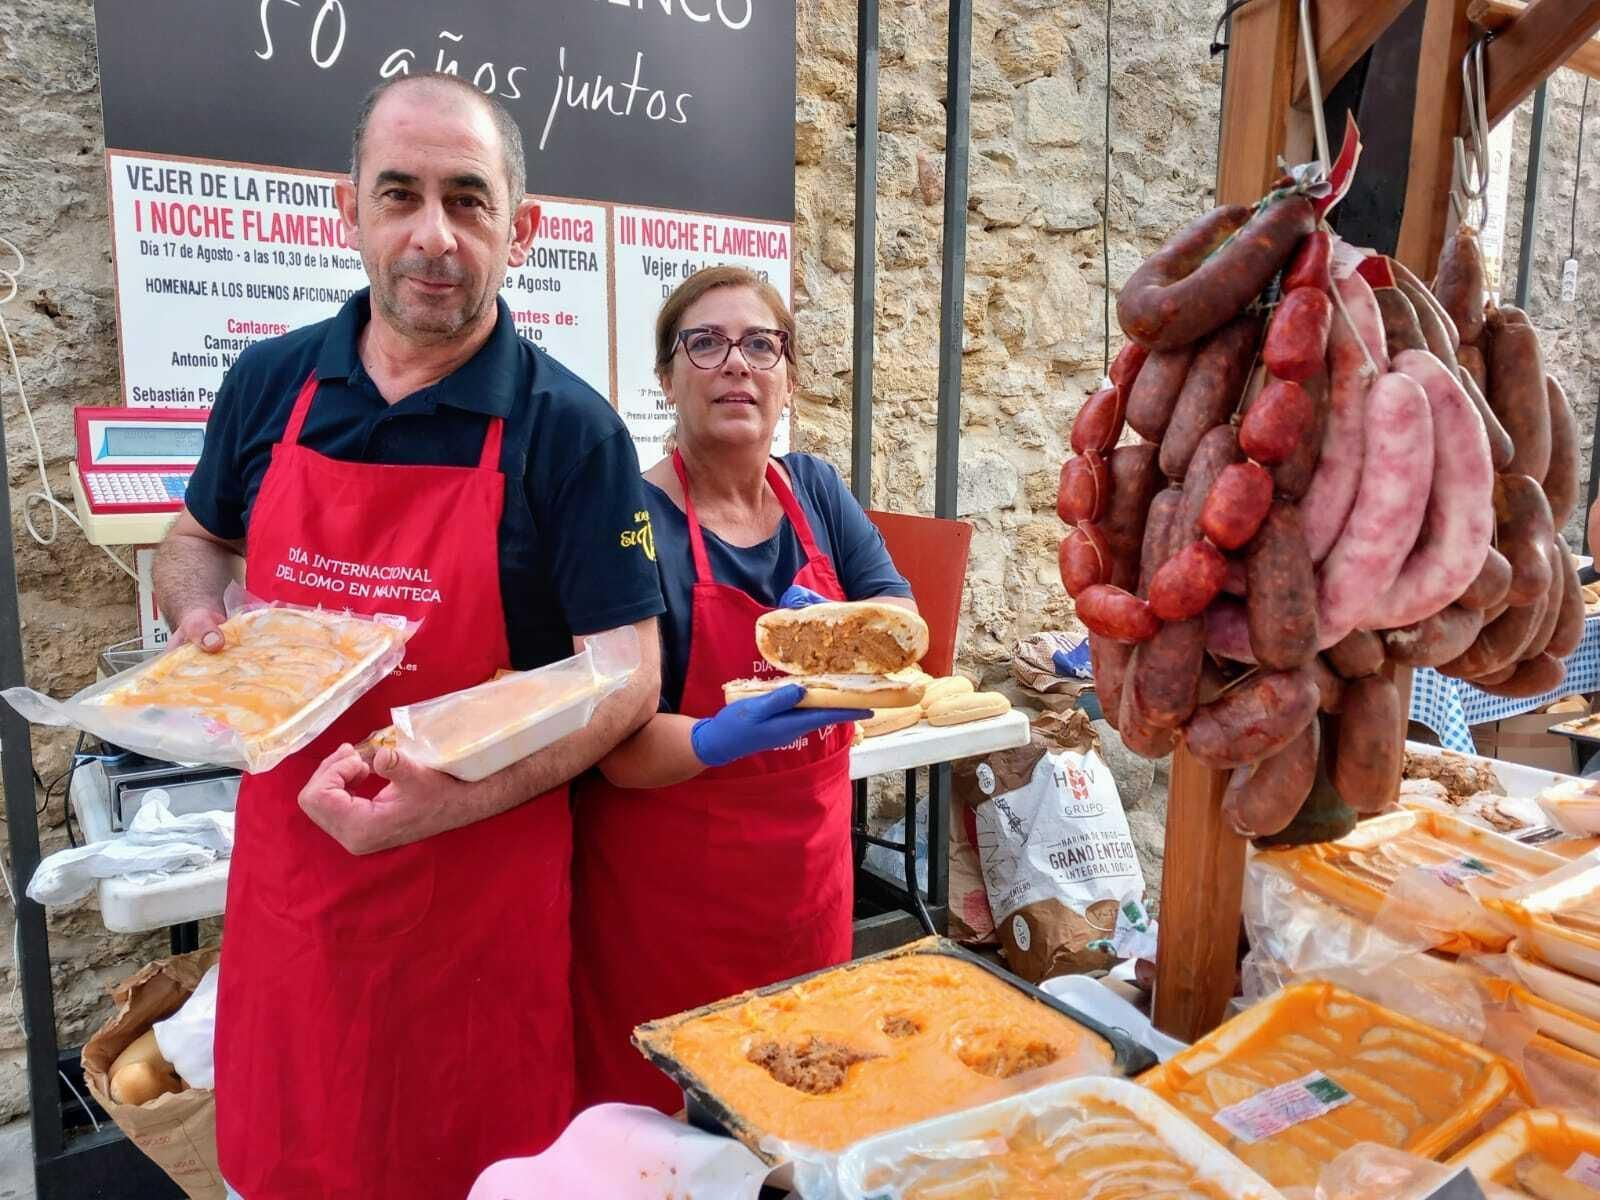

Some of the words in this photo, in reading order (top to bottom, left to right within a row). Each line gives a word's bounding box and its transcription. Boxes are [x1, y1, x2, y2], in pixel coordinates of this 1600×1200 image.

[255, 0, 347, 68] 50
[539, 46, 693, 151] juntos
[126, 165, 193, 195] VEJER
[200, 172, 227, 198] DE
[234, 176, 260, 202] LA
[134, 200, 142, 232] I
[150, 201, 234, 240] NOCHE
[620, 215, 636, 246] III
[641, 218, 699, 251] NOCHE
[703, 224, 788, 260] FLAMENCA
[163, 243, 176, 257] 17
[180, 244, 193, 259] de
[197, 245, 233, 263] Agosto
[243, 251, 251, 263] a
[253, 248, 270, 264] las
[272, 250, 301, 267] 10,30
[304, 253, 317, 267] de
[319, 254, 329, 269] la
[331, 255, 362, 270] Noche
[642, 255, 677, 281] Vejer
[682, 259, 697, 278] de
[145, 278, 208, 296] HOMENAJE
[211, 281, 219, 296] A
[222, 282, 243, 298] LOS
[246, 283, 290, 300] BUENOS
[517, 274, 561, 293] Agosto
[555, 312, 579, 326] de:
[171, 351, 218, 368] Antonio
[132, 386, 195, 402] Sebastián
[288, 547, 309, 566] DÍA
[313, 554, 433, 583] INTERNACIONAL
[275, 564, 297, 582] DEL
[299, 571, 345, 592] LOMO
[349, 582, 370, 597] EN
[373, 585, 442, 603] MANTECA
[1064, 802, 1104, 816] GRUPO
[1049, 844, 1095, 870] GRANO
[1096, 841, 1133, 860] ENTERO
[1065, 862, 1110, 880] INTEGRAL
